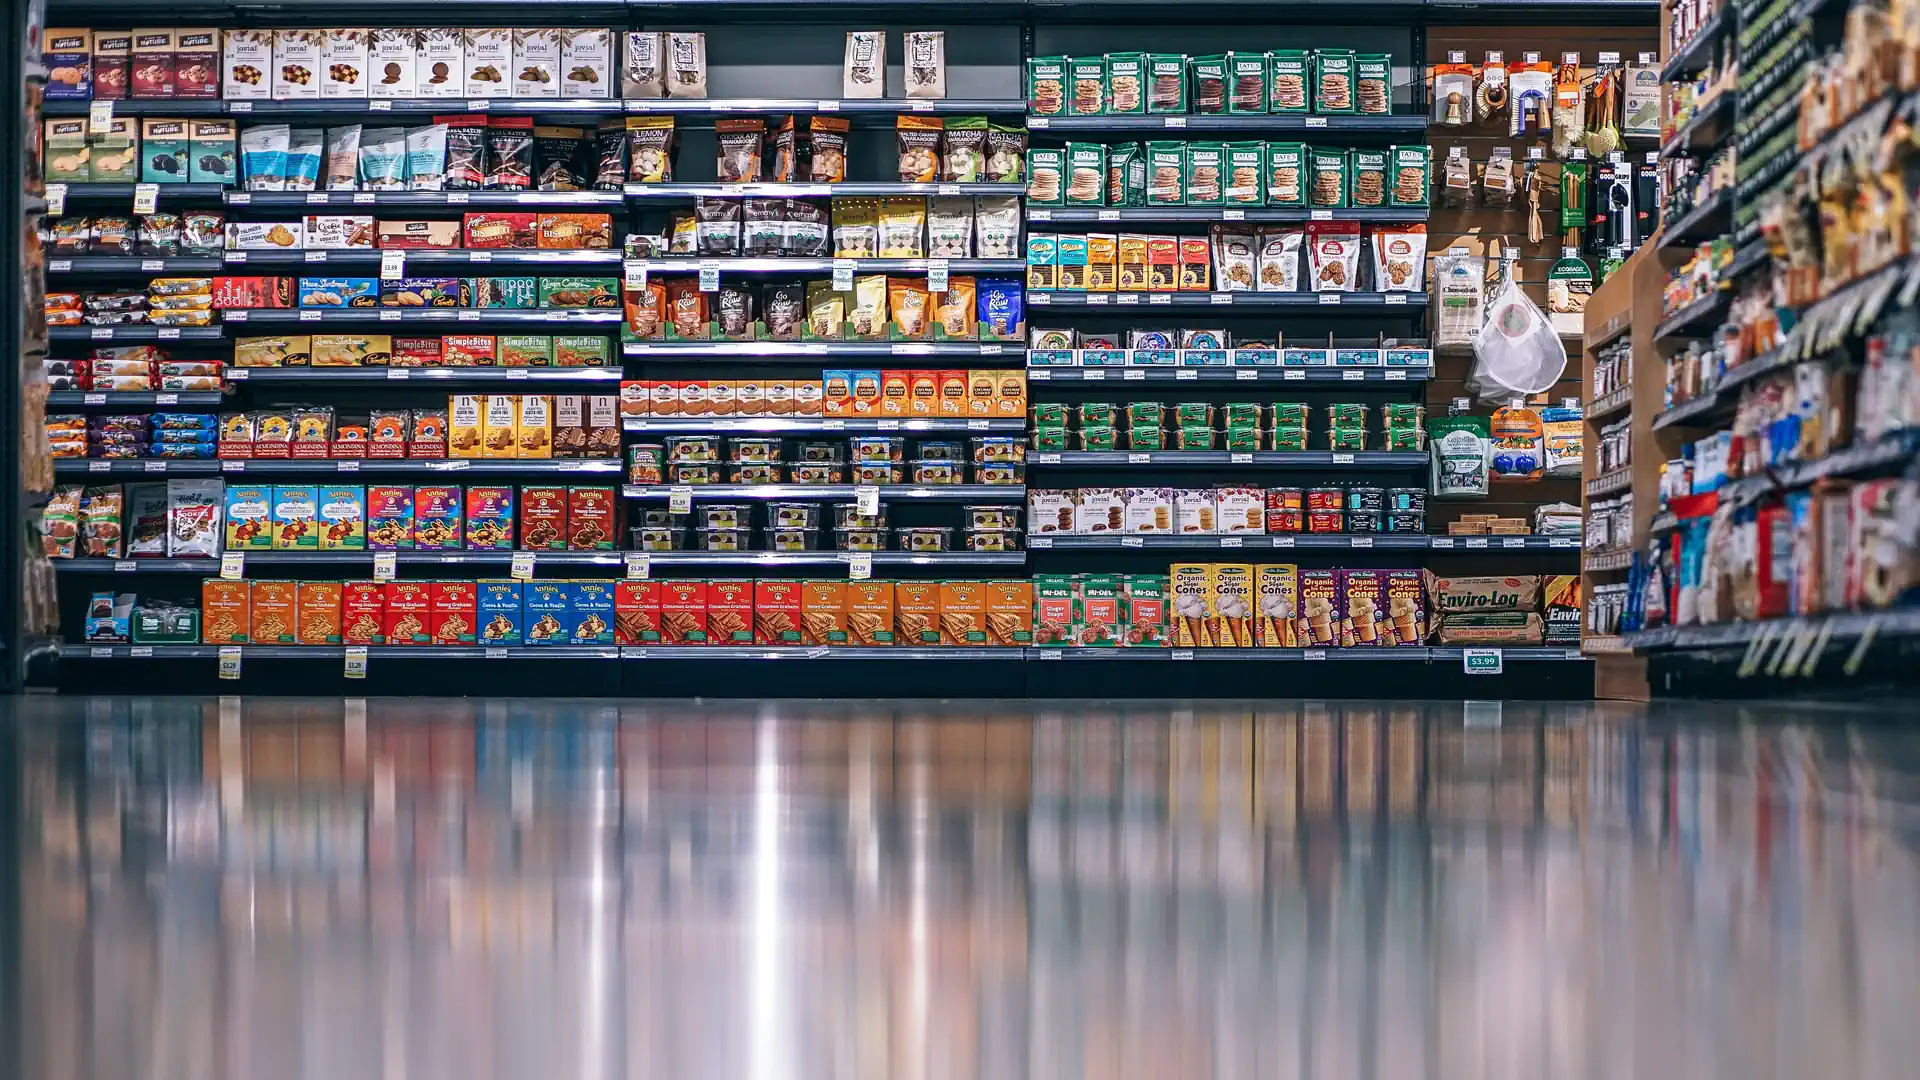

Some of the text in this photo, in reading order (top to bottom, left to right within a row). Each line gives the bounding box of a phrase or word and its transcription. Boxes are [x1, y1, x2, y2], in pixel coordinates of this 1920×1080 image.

[141, 37, 166, 45] NATURE
[183, 37, 208, 45] NATURE
[286, 45, 307, 53] jovial
[334, 44, 354, 52] jovial
[430, 44, 450, 52] jovial
[478, 44, 499, 52] jovial
[527, 44, 547, 52] jovial
[989, 133, 1021, 141] MATCHA
[682, 290, 692, 299] Go
[726, 289, 737, 298] Go
[776, 291, 788, 300] Go
[907, 288, 918, 299] Go
[993, 290, 1005, 300] Go
[678, 297, 696, 310] Raw
[722, 296, 741, 309] Raw
[772, 299, 790, 310] Raw
[904, 296, 923, 307] Raw
[989, 298, 1008, 310] Raw
[396, 340, 439, 349] SimpleBites
[448, 337, 491, 346] SimpleBites
[504, 338, 547, 346] SimpleBites
[559, 338, 601, 346] SimpleBites
[462, 397, 469, 406] n
[497, 397, 504, 406] n
[531, 397, 538, 406] n
[565, 397, 572, 406] n
[599, 397, 606, 406] n
[380, 489, 402, 497] Annie's
[426, 490, 448, 498] Annie's
[1176, 574, 1206, 582] Organic
[1262, 574, 1292, 582] Organic
[1304, 578, 1334, 586] Organic
[1348, 578, 1378, 586] Organic
[1389, 578, 1419, 586] Organic
[1175, 585, 1207, 594] Cones
[1216, 585, 1248, 594] Cones
[1261, 585, 1292, 594] Cones
[1303, 590, 1335, 598] Cones
[1347, 590, 1378, 598] Cones
[1389, 590, 1420, 598] Cones
[1439, 591, 1519, 607] Enviro-Log
